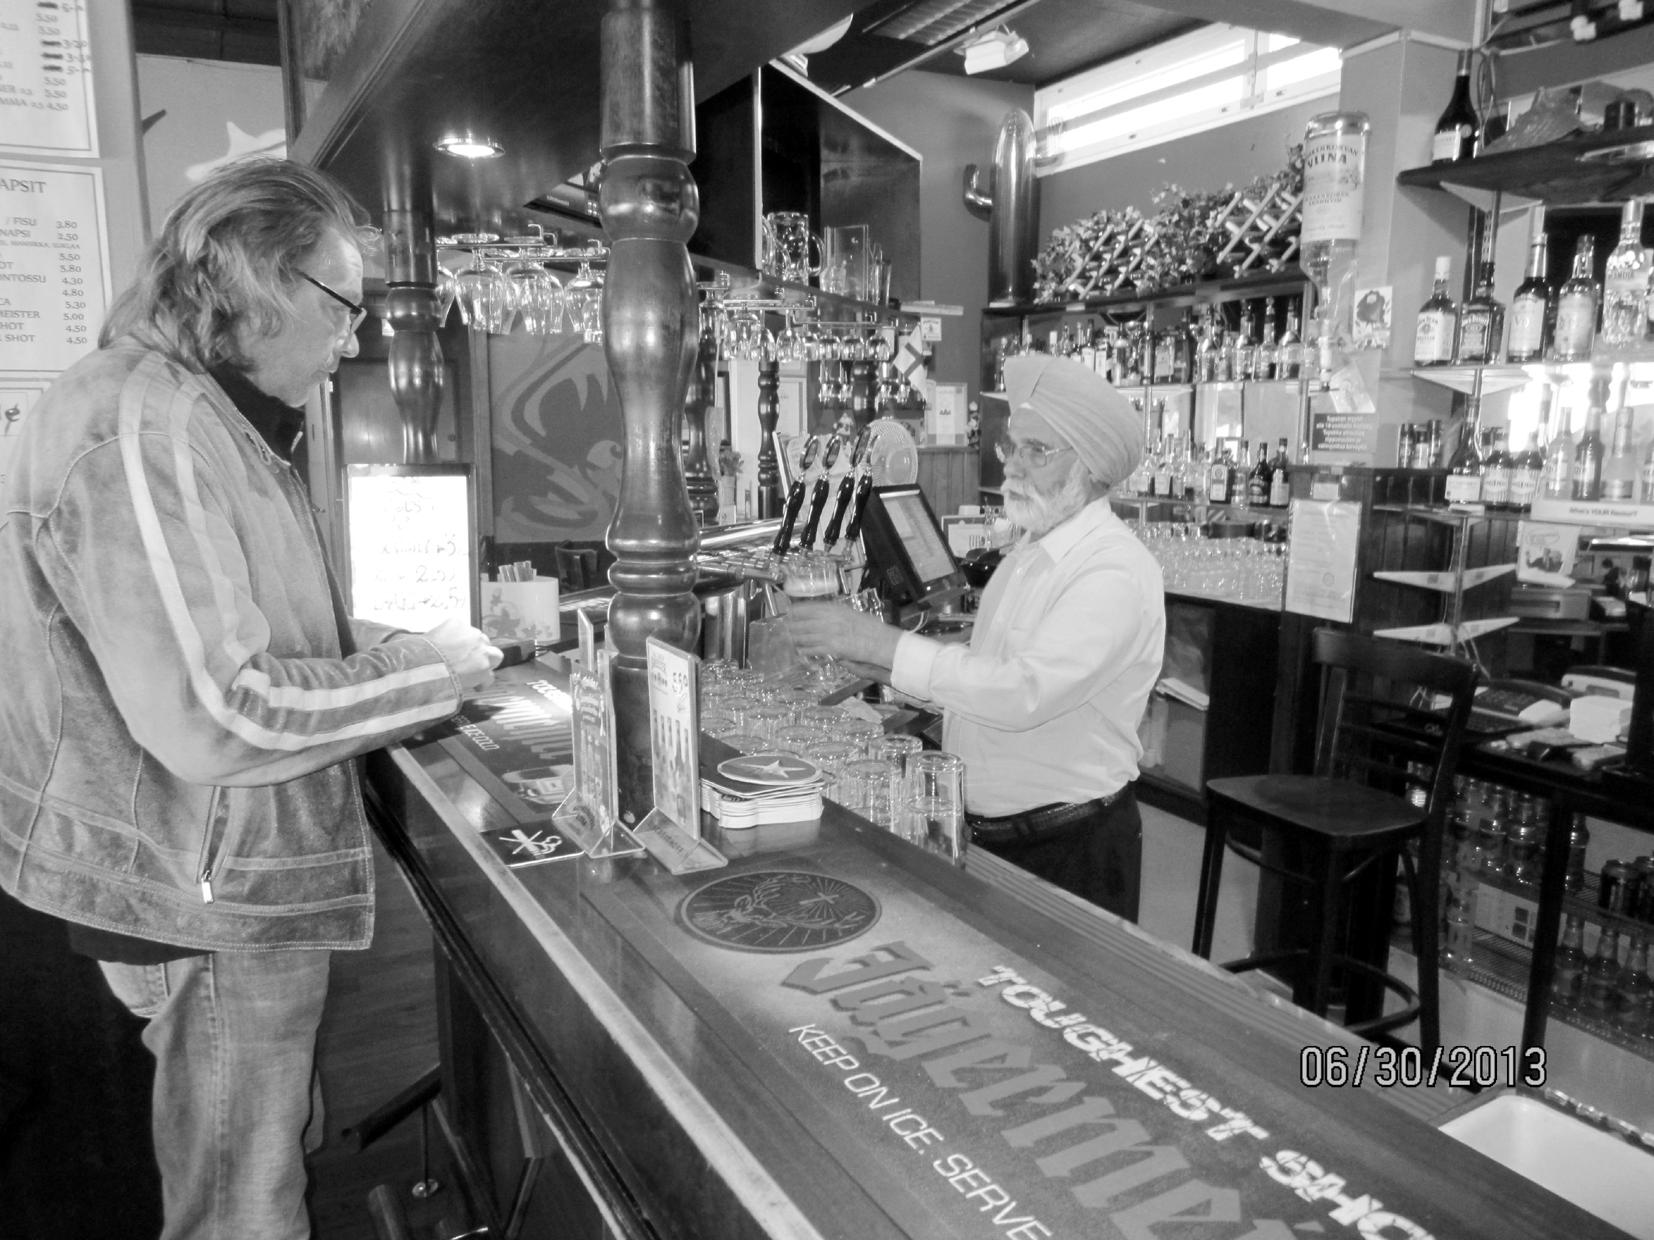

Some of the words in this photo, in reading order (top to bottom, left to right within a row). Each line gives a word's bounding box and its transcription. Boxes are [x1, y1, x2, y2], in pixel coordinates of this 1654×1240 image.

[788, 1023, 860, 1071] KEEP
[844, 1072, 899, 1109] ON
[932, 1153, 1052, 1240] SERVE
[977, 964, 1270, 1141] TOUGHEST
